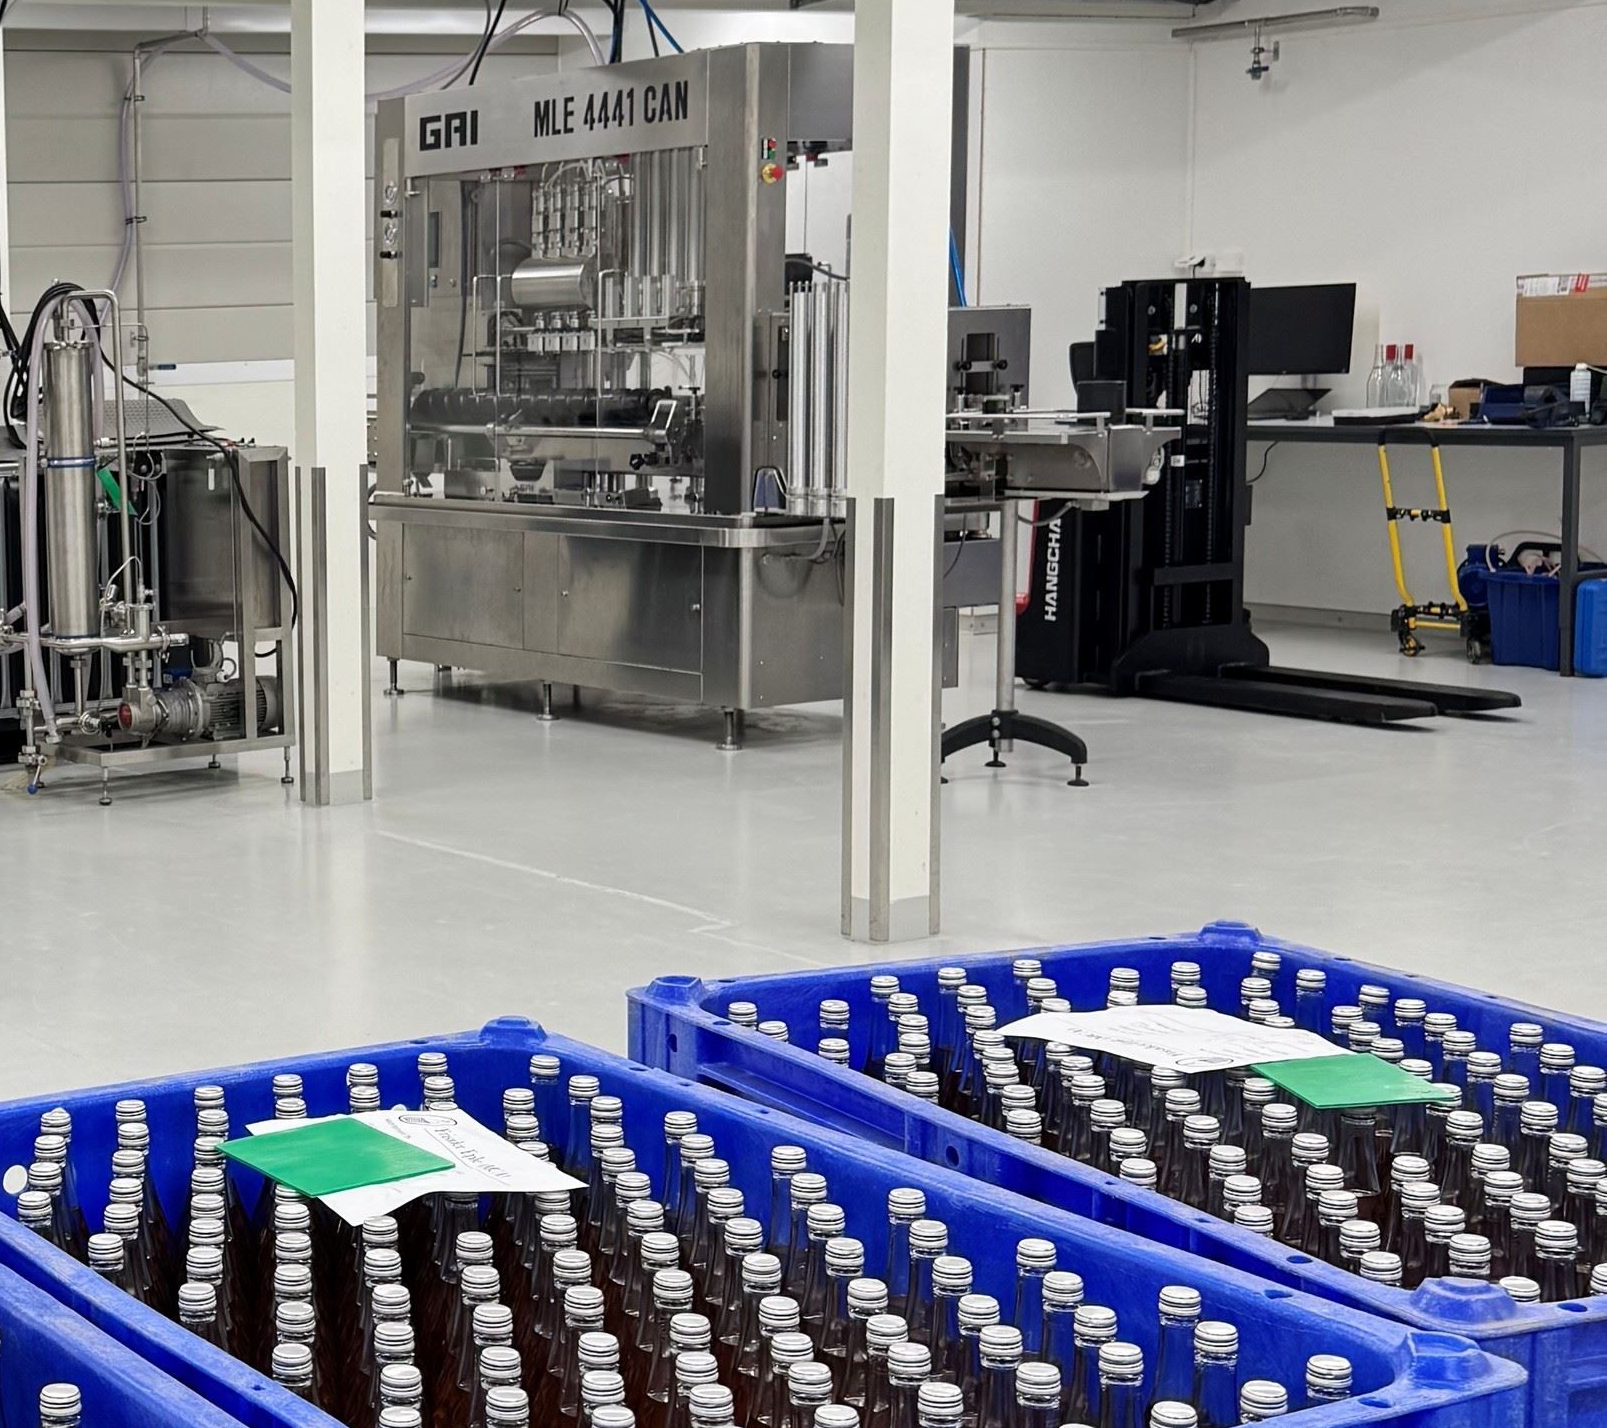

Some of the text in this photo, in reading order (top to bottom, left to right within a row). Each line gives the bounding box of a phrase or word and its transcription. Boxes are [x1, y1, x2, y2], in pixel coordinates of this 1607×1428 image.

[419, 110, 478, 151] GAI
[534, 80, 688, 138] MLE 4441 CAN
[1044, 518, 1061, 622] HANGCHA
